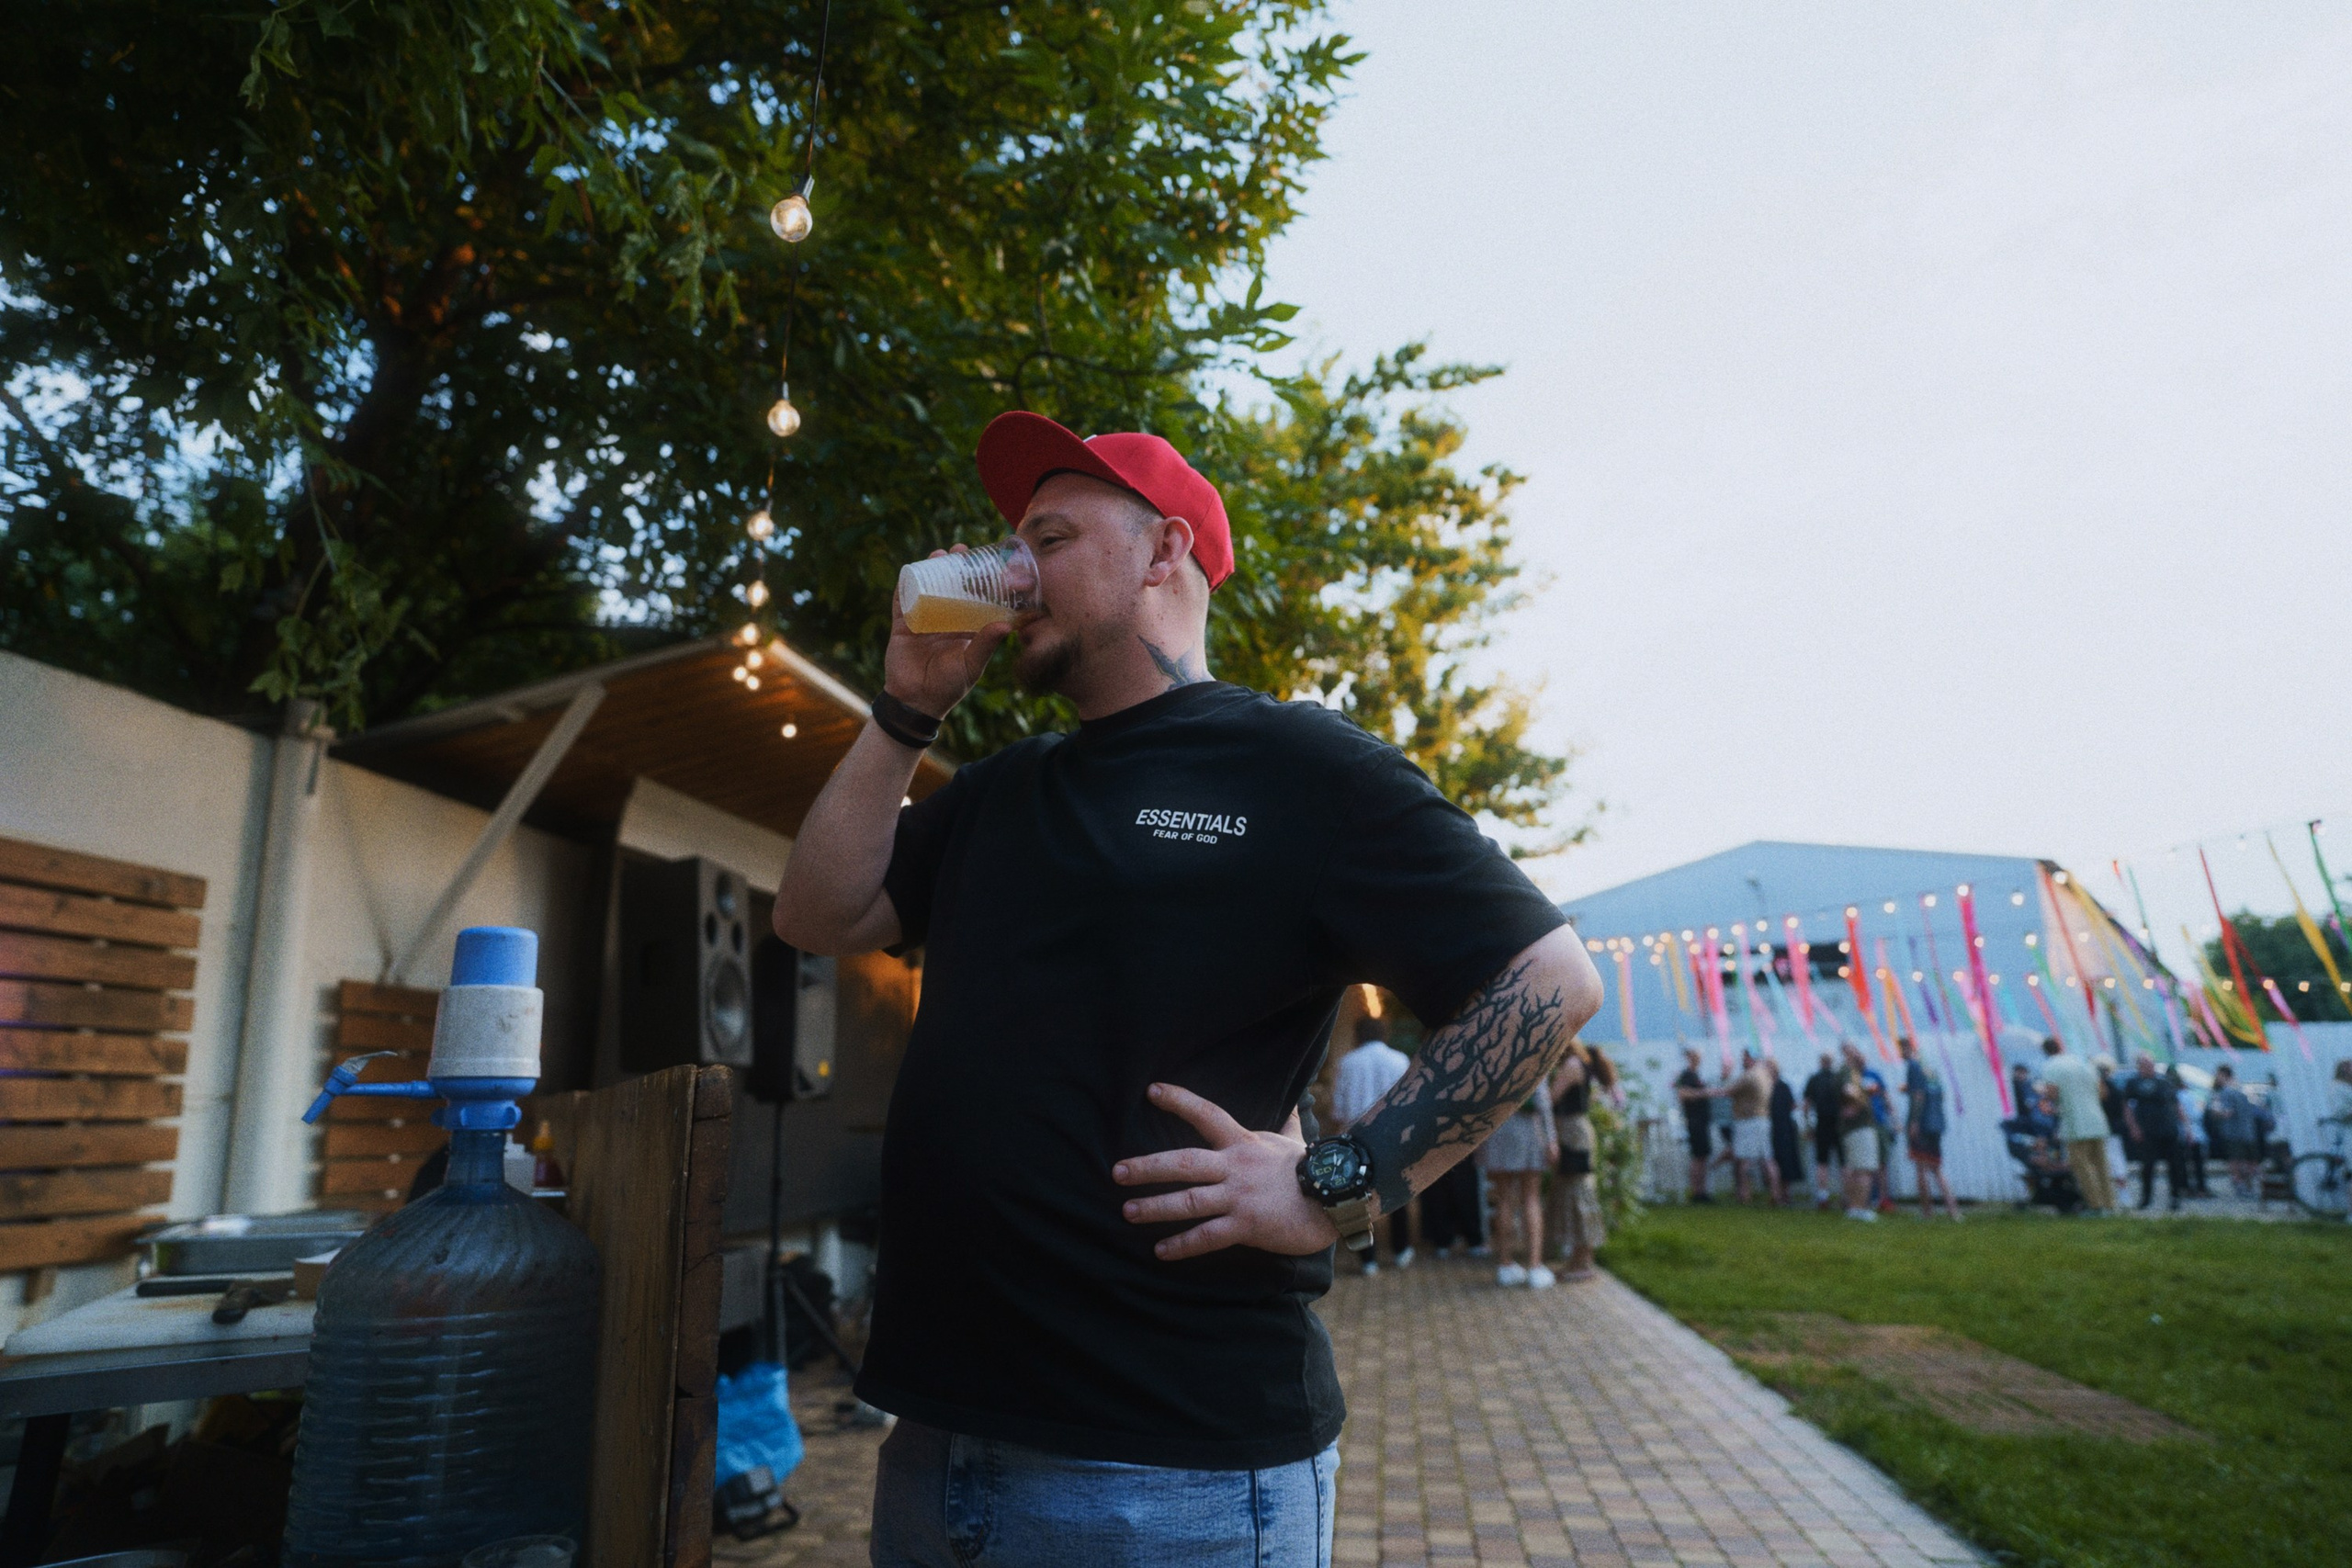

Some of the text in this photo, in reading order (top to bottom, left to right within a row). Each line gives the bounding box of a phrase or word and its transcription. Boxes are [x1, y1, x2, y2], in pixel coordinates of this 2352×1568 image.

[1136, 808, 1248, 836] ESSENTIALS
[1152, 829, 1218, 844] FEAR OF GOD
[1335, 1178, 1346, 1186] 12
